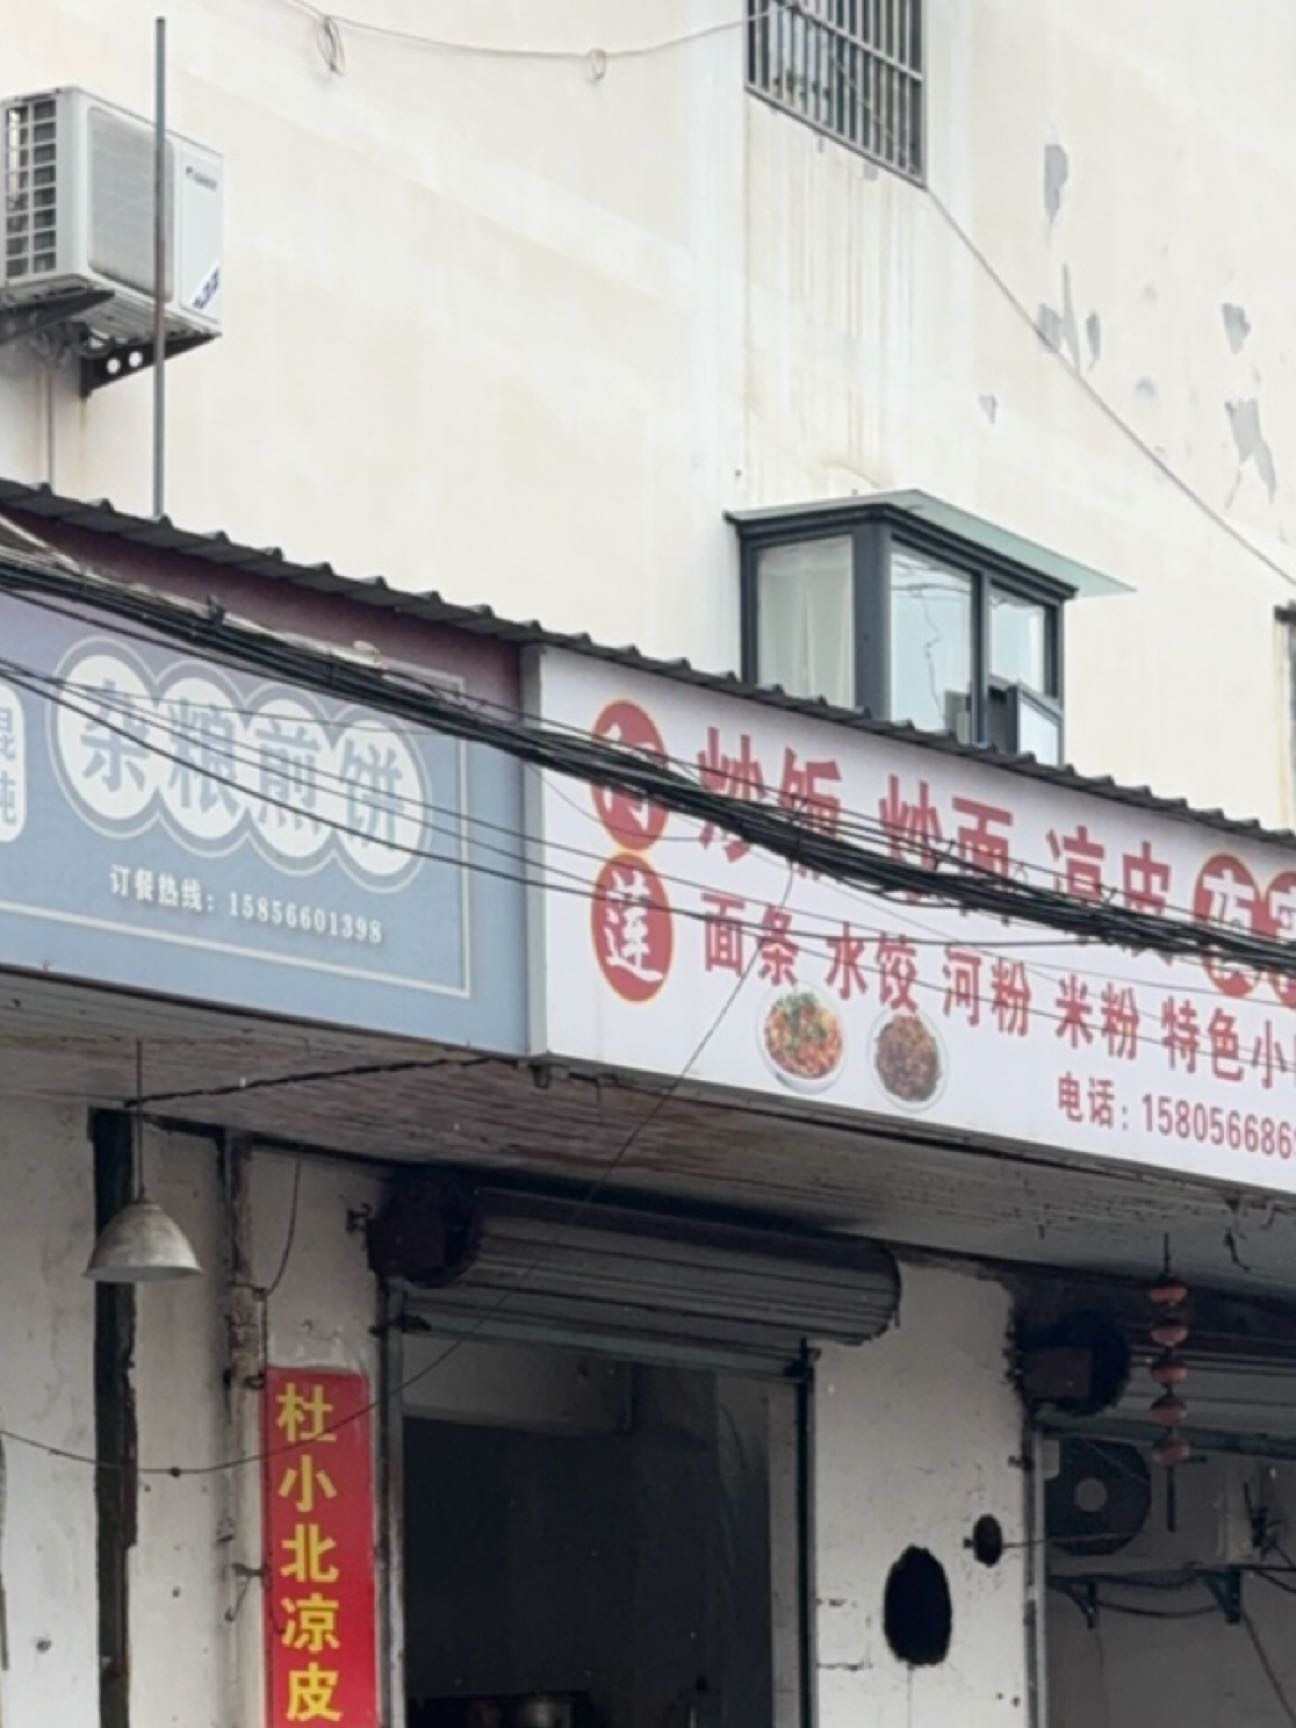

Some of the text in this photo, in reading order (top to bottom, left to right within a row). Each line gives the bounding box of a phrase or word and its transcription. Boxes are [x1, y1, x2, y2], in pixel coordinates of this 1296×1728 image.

[81, 681, 406, 848] 杂粮煎饼
[700, 892, 1296, 1090] 面条 水饺 河粉 米粉 特色小
[1057, 1071, 1296, 1161] 电话：158056686
[275, 1382, 343, 1723] 杜小北凉皮
